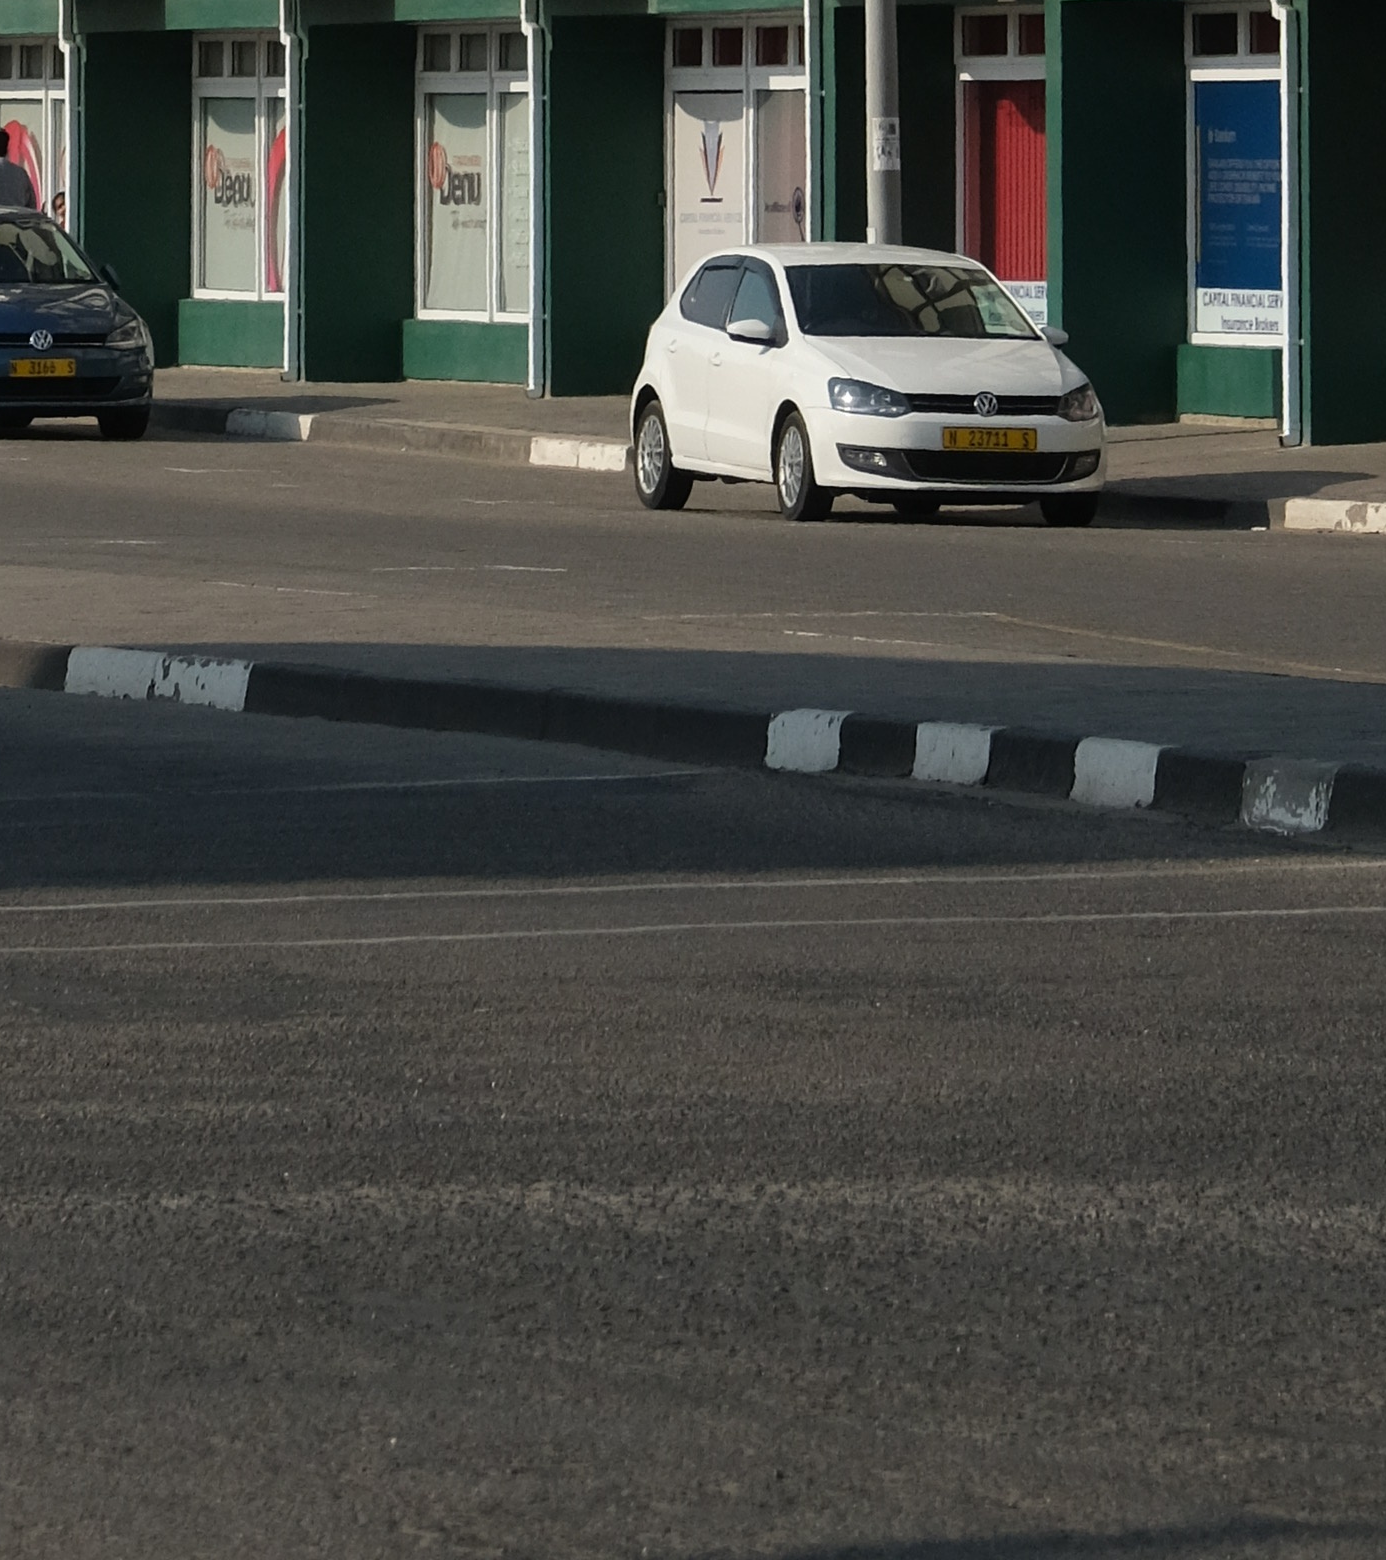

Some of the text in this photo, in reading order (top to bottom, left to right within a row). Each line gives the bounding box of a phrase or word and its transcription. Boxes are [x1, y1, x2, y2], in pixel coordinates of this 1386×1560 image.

[1202, 290, 1229, 307] CAPITAL
[1230, 292, 1265, 308] FINANCIAL
[1221, 315, 1279, 332] Insurance Brokers
[67, 361, 74, 374] S
[949, 430, 1029, 447] N 23711 S
